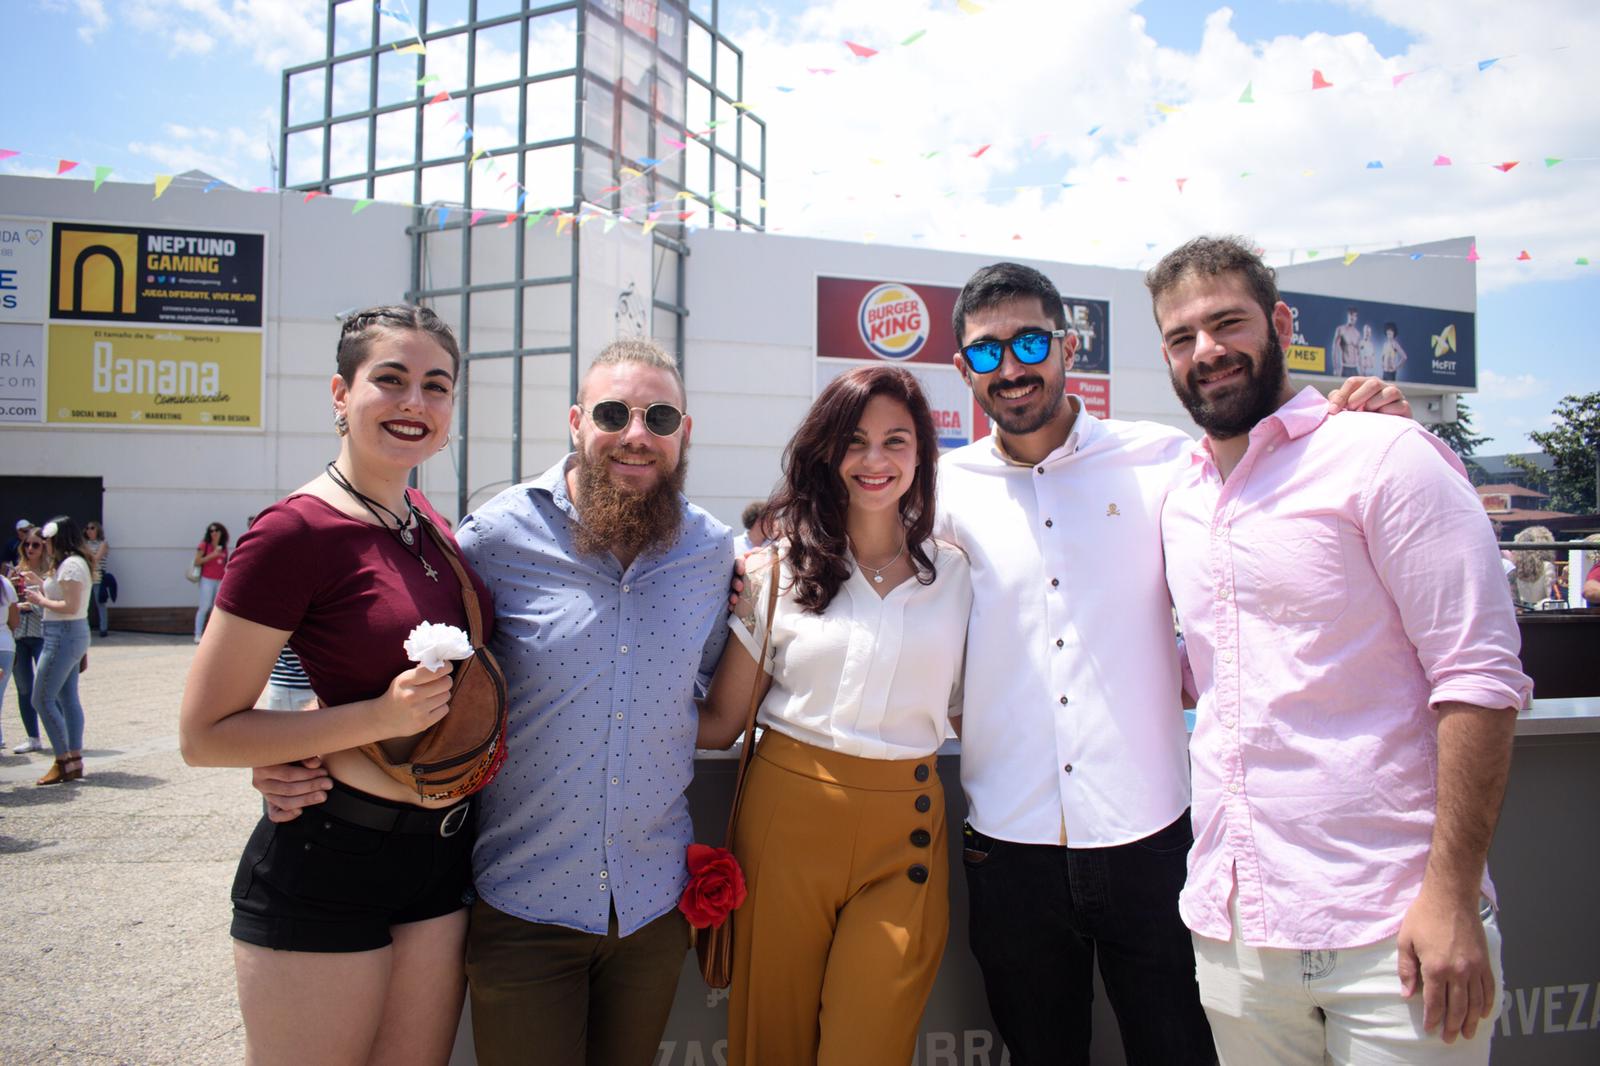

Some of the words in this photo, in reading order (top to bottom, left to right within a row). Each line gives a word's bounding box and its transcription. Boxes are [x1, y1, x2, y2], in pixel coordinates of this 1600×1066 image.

[0, 230, 21, 243] DA
[147, 235, 236, 256] NEPTUNO
[147, 254, 219, 273] GAMING
[0, 295, 18, 309] S
[142, 289, 168, 298] JUEGA
[212, 292, 230, 301] VIVE
[230, 293, 257, 302] MEJOR
[868, 300, 918, 323] BURGER
[870, 313, 921, 342] KING
[1295, 350, 1316, 361] MES
[93, 341, 220, 396] Banana
[1432, 360, 1457, 371] McFIT
[71, 410, 95, 418] SOCIAL
[96, 410, 117, 418] MEDIA
[145, 412, 182, 420] MARKETING
